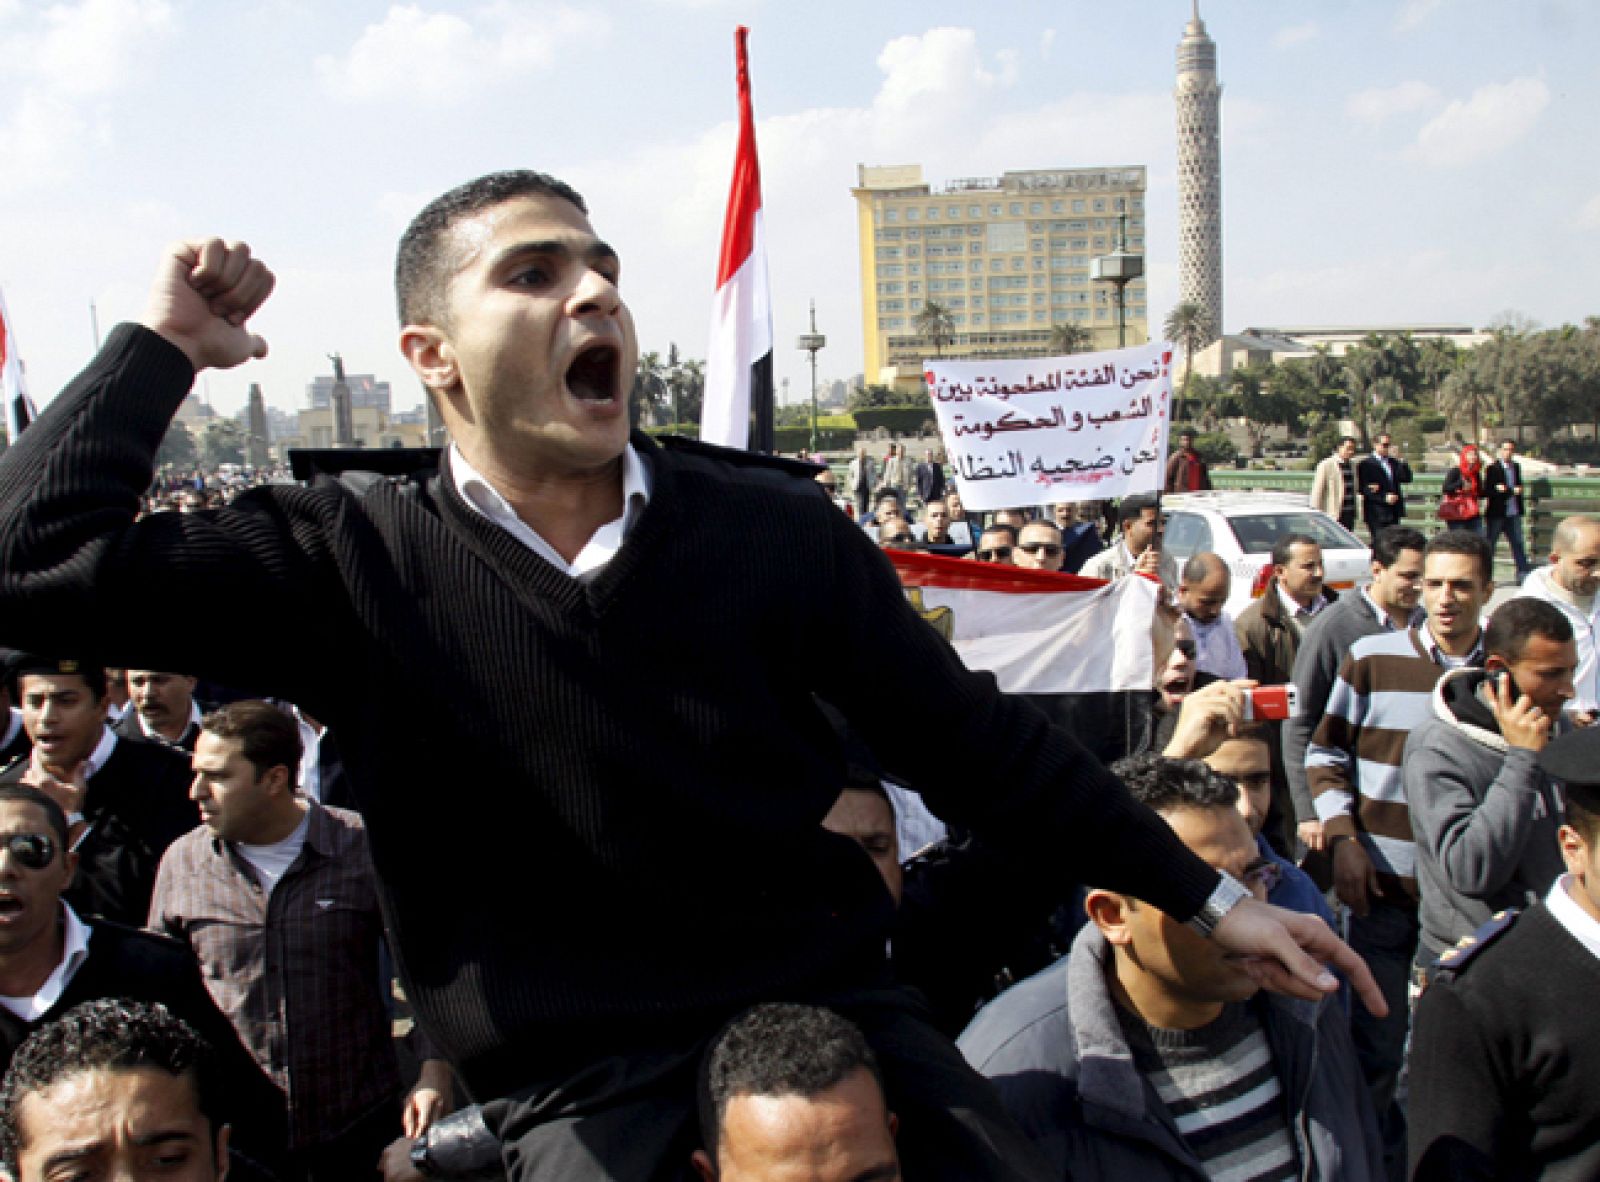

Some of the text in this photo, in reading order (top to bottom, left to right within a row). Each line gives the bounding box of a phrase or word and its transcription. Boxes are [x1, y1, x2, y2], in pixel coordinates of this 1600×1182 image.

[1120, 359, 1159, 389] نحن
[937, 377, 972, 402] بين
[1088, 397, 1152, 429] الشعب
